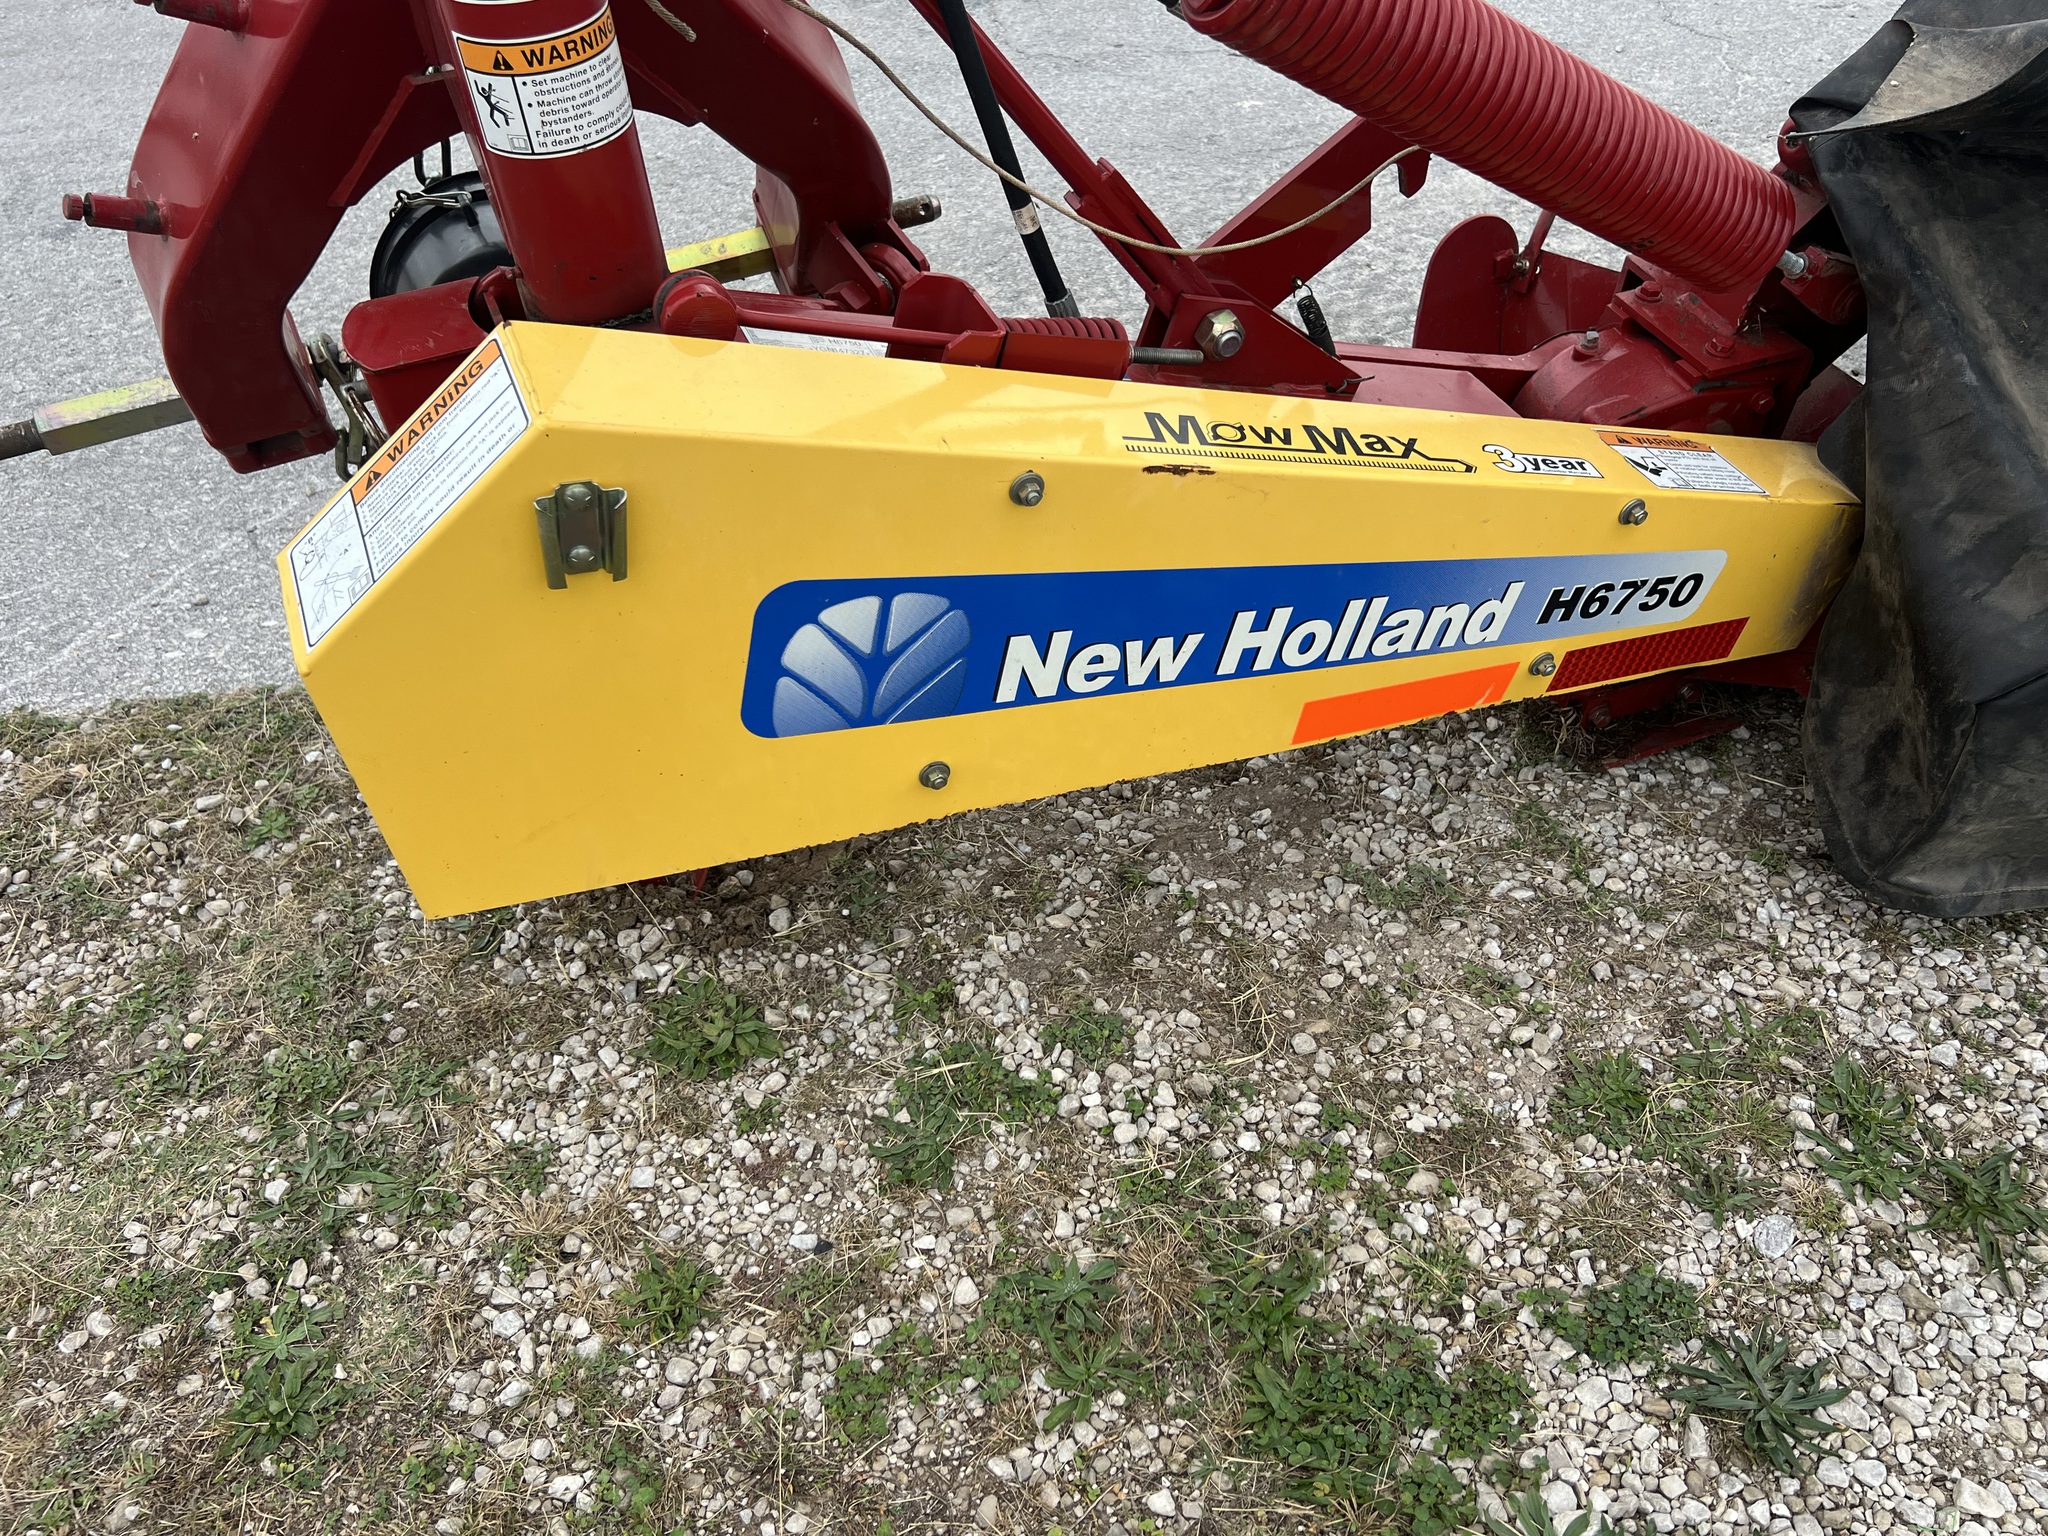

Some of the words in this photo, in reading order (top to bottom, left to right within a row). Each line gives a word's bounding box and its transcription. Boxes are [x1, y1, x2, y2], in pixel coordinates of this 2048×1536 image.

[520, 16, 613, 68] WARNING
[531, 78, 548, 87] Set
[550, 67, 588, 84] machine
[588, 63, 597, 72] to
[598, 53, 612, 67] clear
[533, 75, 592, 97] obstructions
[593, 69, 606, 81] and
[536, 93, 577, 109] Machine
[579, 88, 595, 99] can
[595, 77, 613, 92] throw
[539, 105, 570, 118] debris
[571, 94, 601, 111] toward
[535, 127, 572, 139] Failure
[574, 123, 584, 132] to
[587, 109, 615, 128] comply
[538, 139, 548, 148] in
[551, 134, 580, 147] death
[583, 131, 593, 140] or
[595, 116, 621, 136] serious
[541, 110, 595, 128] bystanders.
[828, 338, 862, 347] H6750
[387, 360, 484, 463] WARNING
[1143, 411, 1294, 446] Mow
[1301, 424, 1419, 460] Max
[1631, 436, 1699, 449] WARNING
[375, 540, 399, 567] Failure
[400, 531, 407, 542] to
[409, 505, 433, 534] comply
[435, 483, 454, 506] could
[456, 461, 476, 485] result
[477, 453, 484, 463] in
[486, 431, 506, 454] death
[507, 421, 515, 432] or
[377, 545, 402, 574] serious
[995, 630, 1203, 704] New
[1216, 582, 1525, 675] Holland
[1536, 571, 1705, 626] H6750
